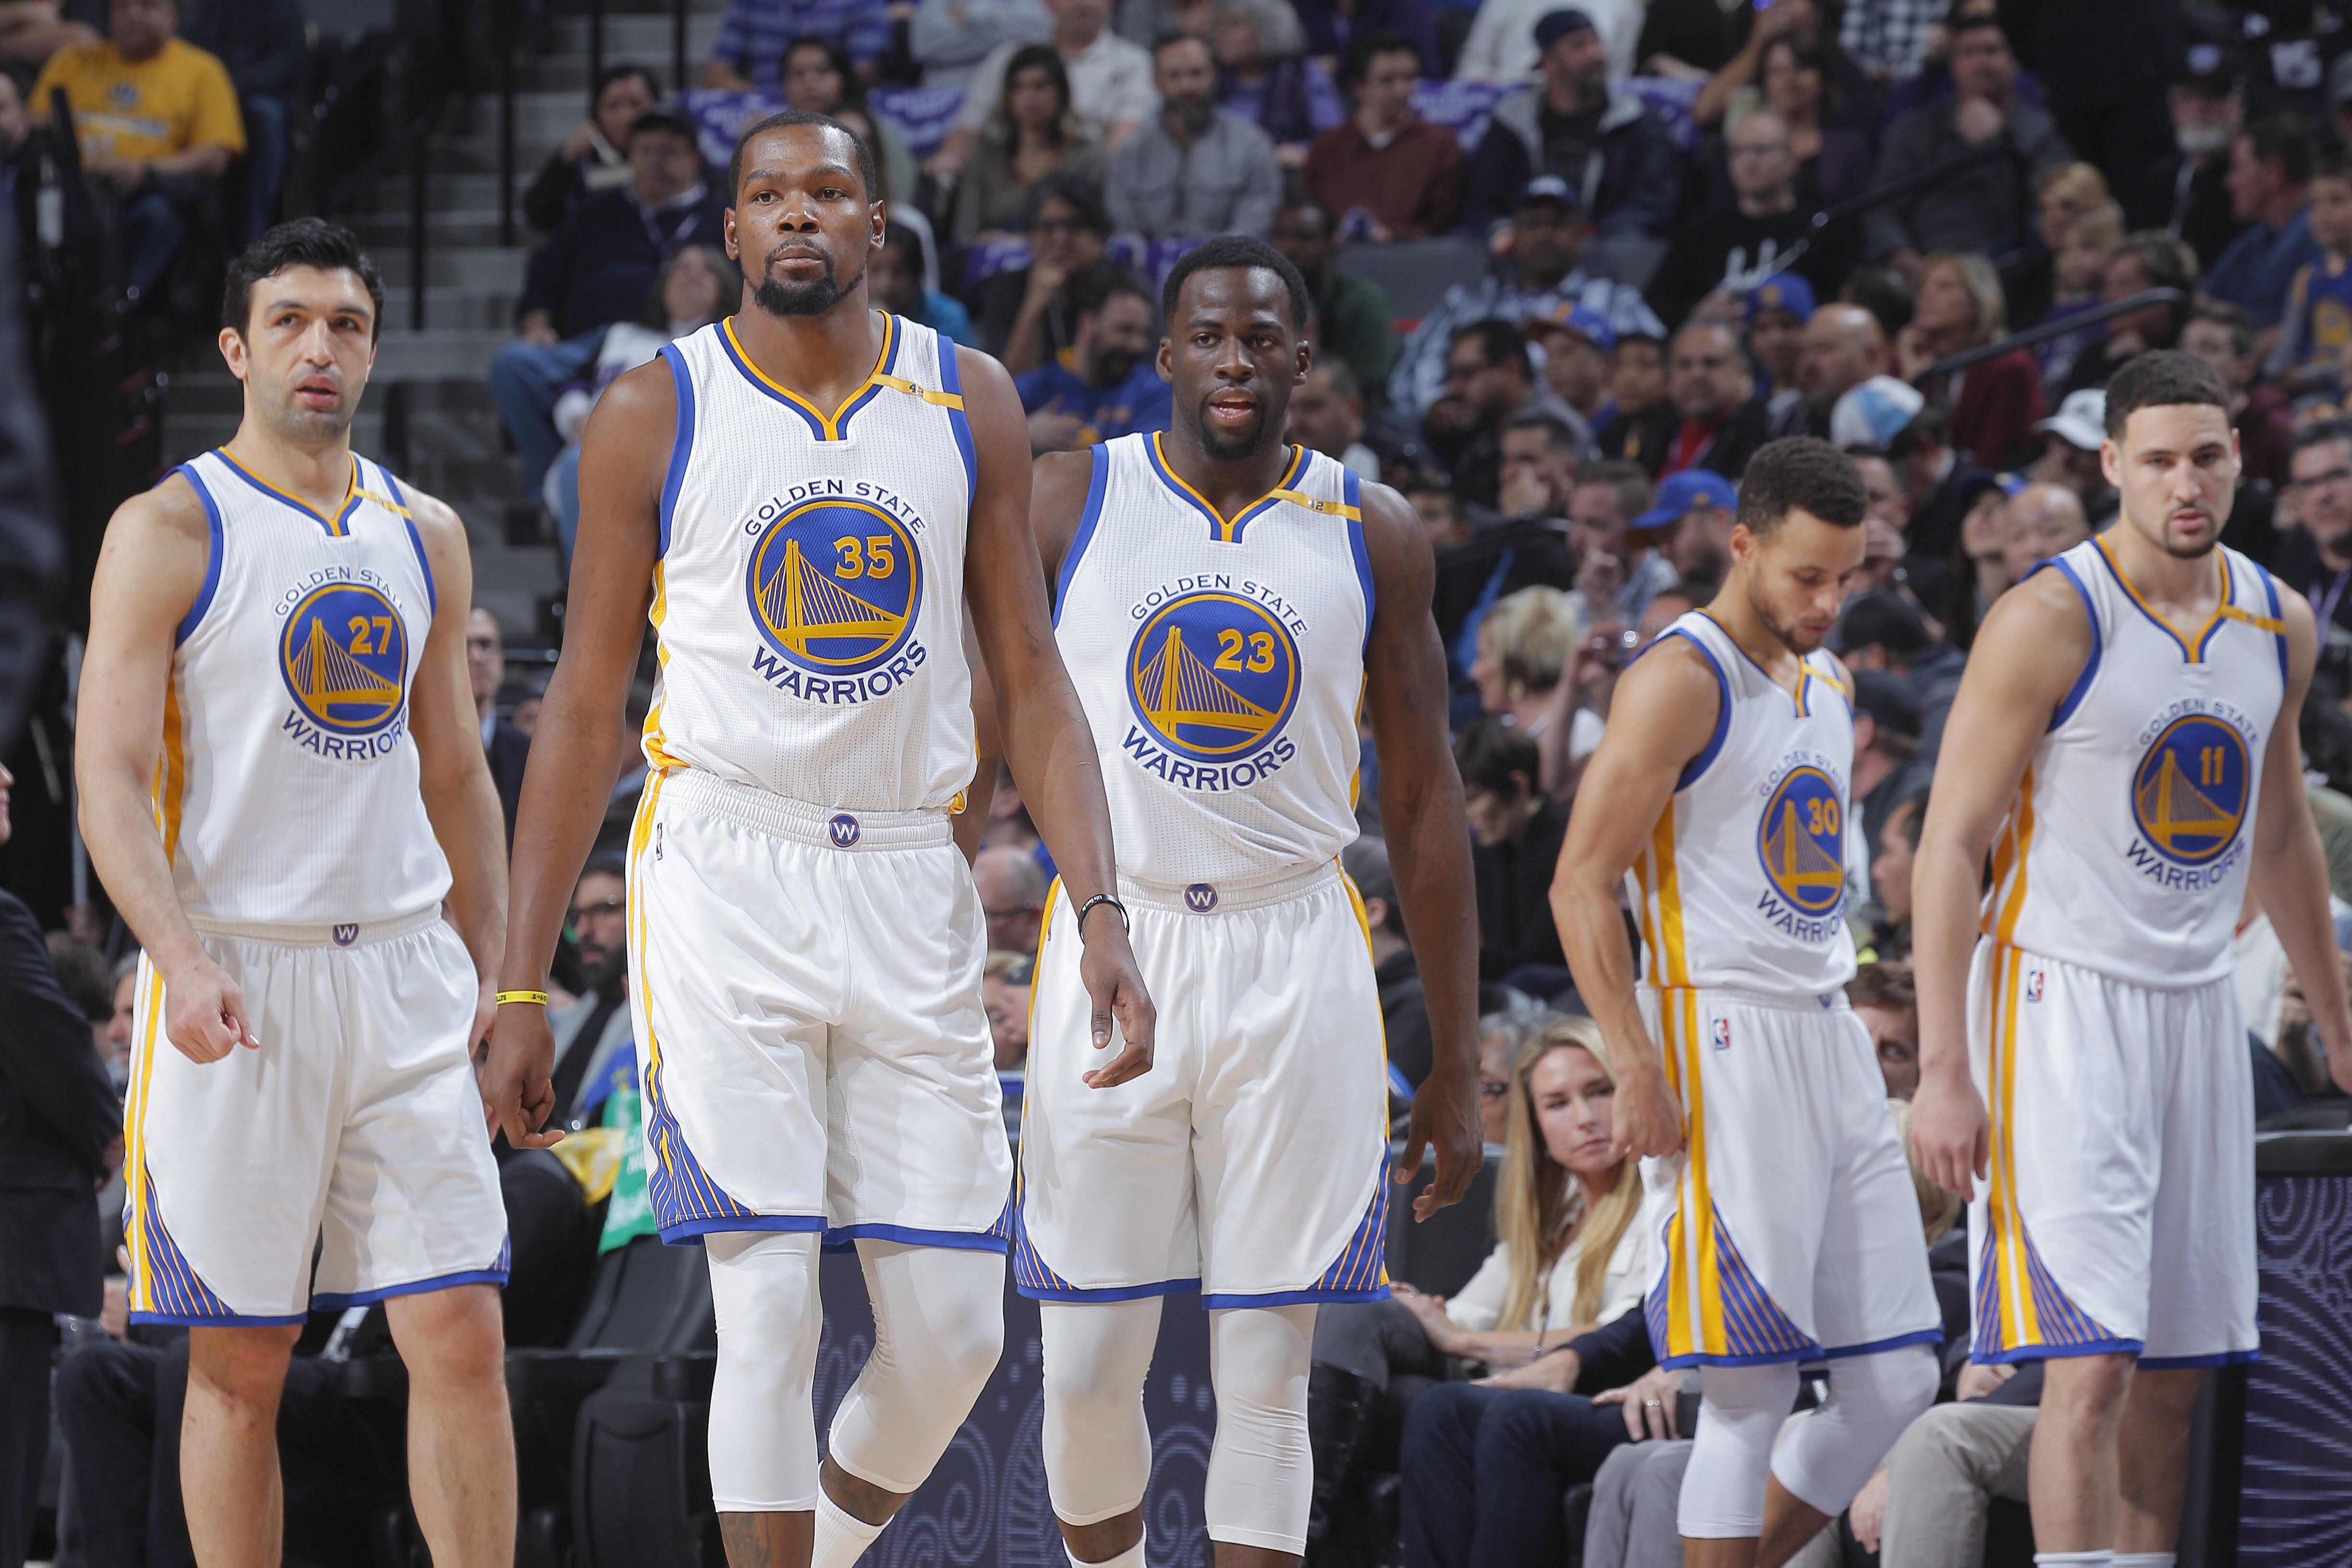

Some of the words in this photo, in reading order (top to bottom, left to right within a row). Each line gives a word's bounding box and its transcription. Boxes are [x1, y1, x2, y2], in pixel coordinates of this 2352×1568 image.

[909, 384, 924, 398] 42
[745, 479, 843, 536] GOLDEN
[855, 482, 926, 535] STATE
[833, 534, 895, 579] 35
[275, 566, 350, 616] GOLDEN
[360, 569, 404, 617] STATE
[1131, 574, 1230, 621] GOLDEN
[1242, 581, 1307, 637] STATE
[348, 615, 392, 655] 27
[1213, 628, 1275, 674] 23
[751, 640, 927, 704] WARRIORS
[2140, 698, 2205, 745] GOLDEN
[1122, 725, 1296, 791] WARRIORS
[2199, 746, 2225, 786] 11
[833, 822, 856, 841] W
[1807, 797, 1839, 836] 30
[1188, 891, 1213, 906] W
[337, 925, 355, 940] W
